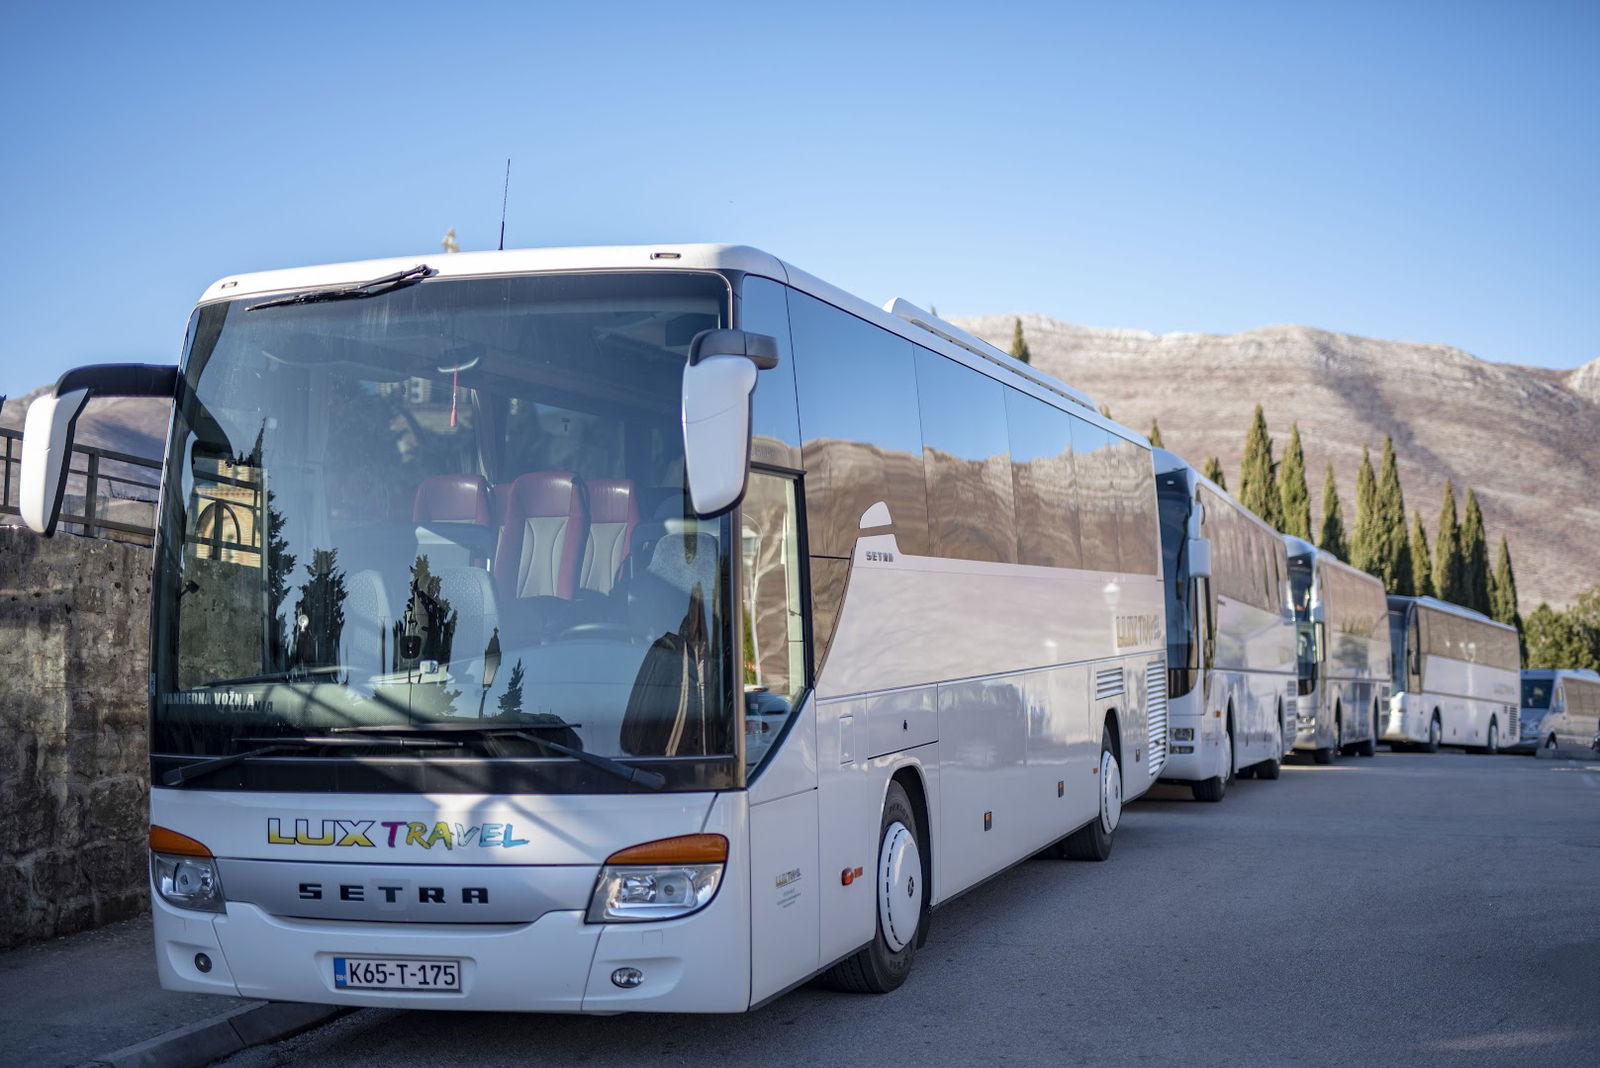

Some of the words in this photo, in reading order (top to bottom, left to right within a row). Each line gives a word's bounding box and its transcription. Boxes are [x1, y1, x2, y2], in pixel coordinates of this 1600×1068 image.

[267, 817, 376, 848] LUX
[380, 821, 530, 851] TRAVEL
[298, 883, 489, 904] SETRA
[349, 962, 456, 986] K65-T-175
